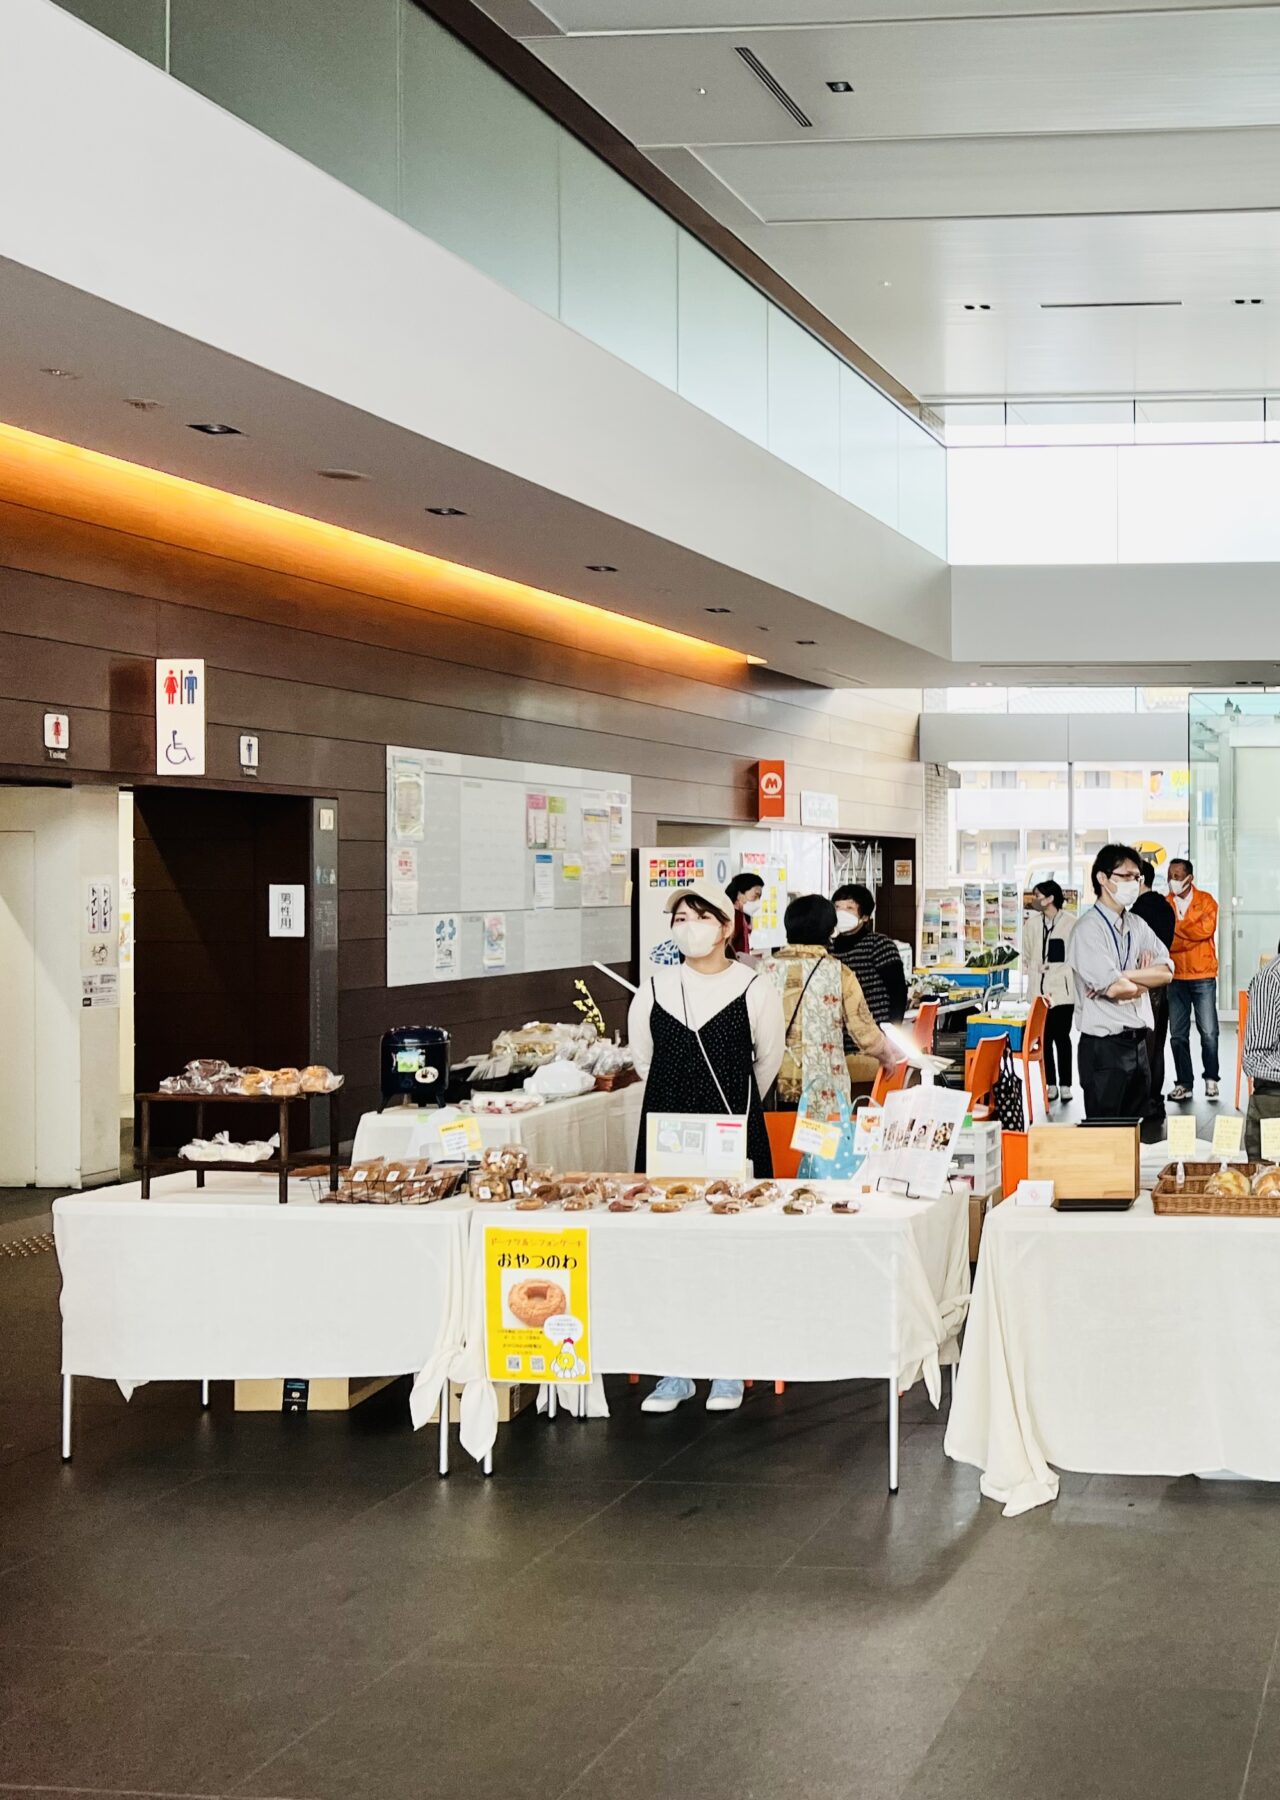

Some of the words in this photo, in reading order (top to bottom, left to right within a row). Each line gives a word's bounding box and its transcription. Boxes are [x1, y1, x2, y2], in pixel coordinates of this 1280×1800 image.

[49, 749, 66, 760] Toilet
[280, 892, 292, 929] 男性用
[497, 1252, 577, 1269] おやつのわ
